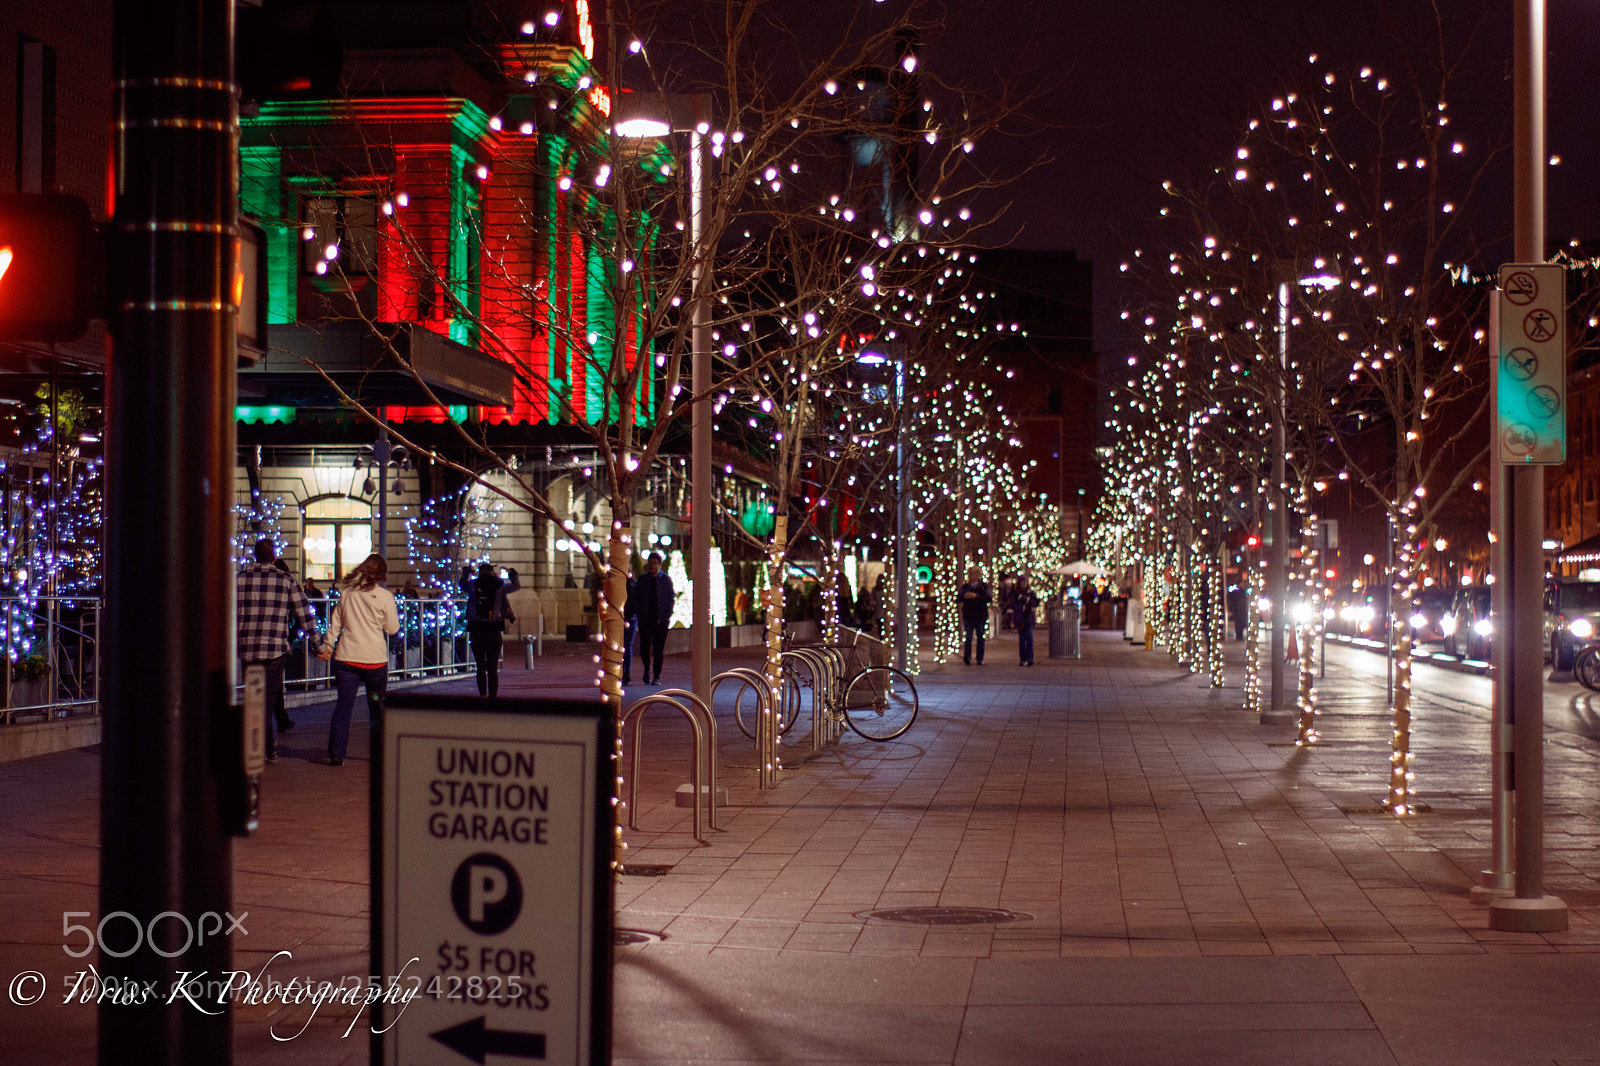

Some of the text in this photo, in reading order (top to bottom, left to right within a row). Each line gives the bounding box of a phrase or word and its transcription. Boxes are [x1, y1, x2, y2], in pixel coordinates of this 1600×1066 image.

[436, 748, 536, 779] UNION
[429, 780, 549, 812] STATION
[428, 812, 549, 845] GARAGE
[469, 864, 510, 923] P
[437, 940, 536, 978] $5 FOR
[448, 977, 550, 1012] HOURS
